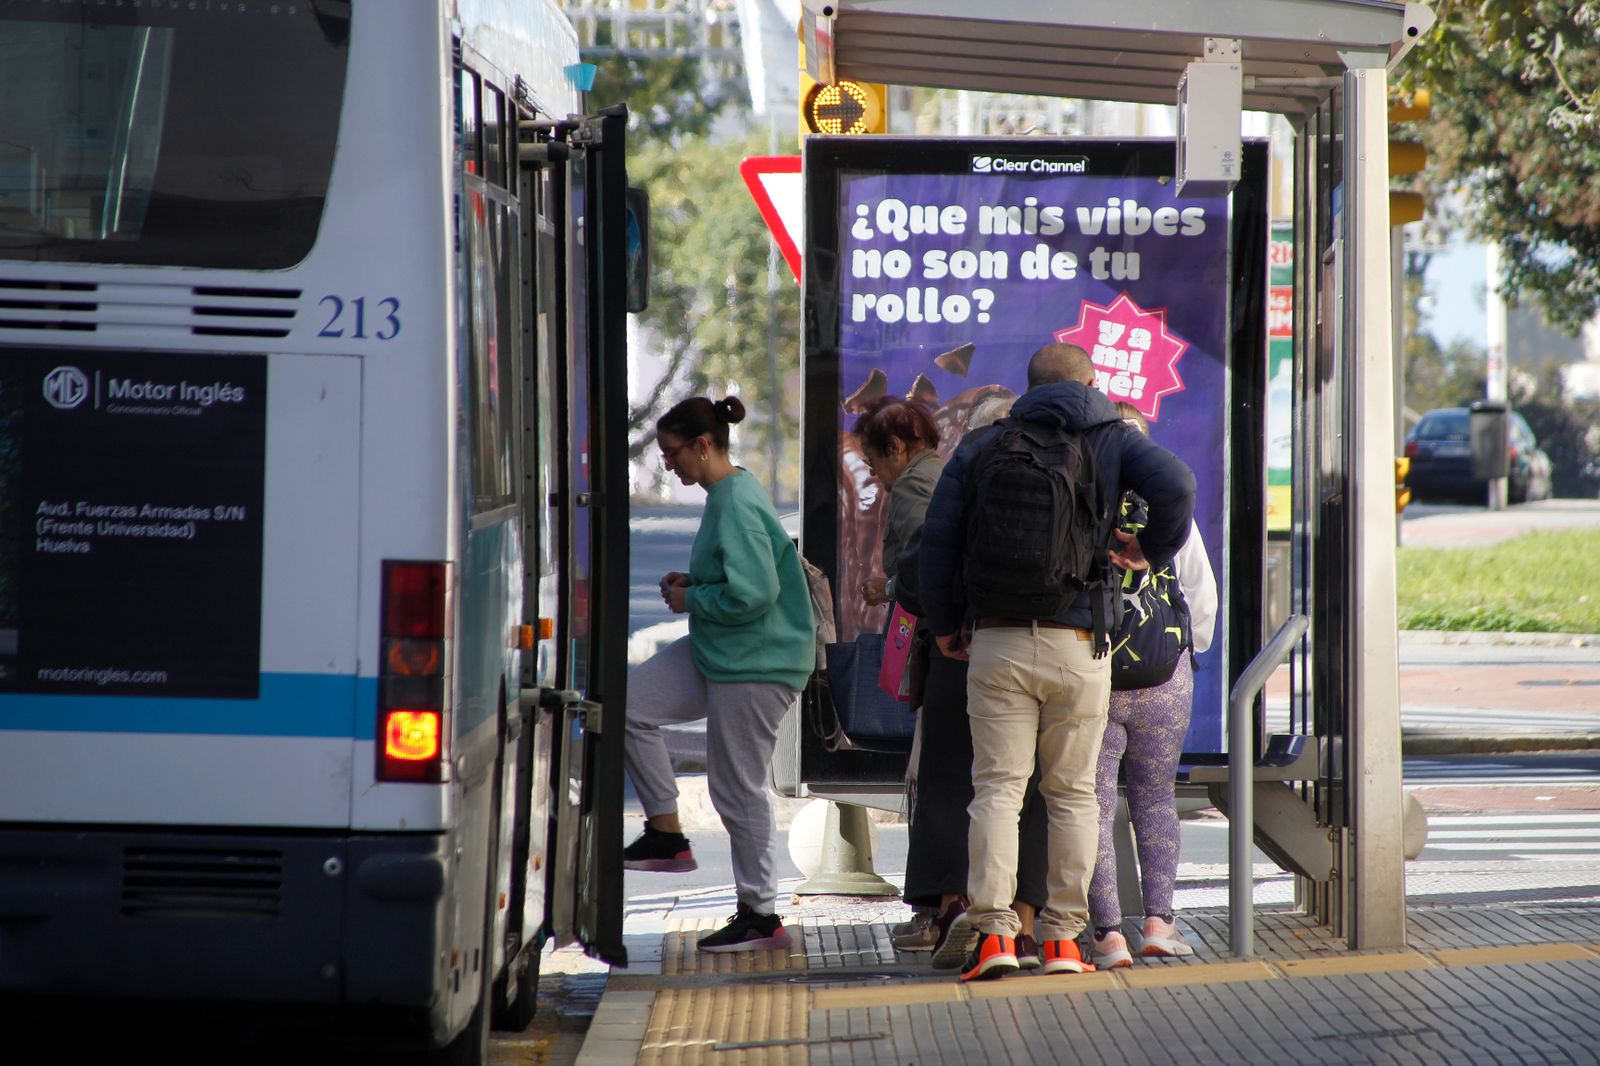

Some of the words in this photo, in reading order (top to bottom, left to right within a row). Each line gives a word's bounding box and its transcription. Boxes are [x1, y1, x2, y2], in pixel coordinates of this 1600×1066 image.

[992, 158, 1029, 172] Clear
[1030, 158, 1085, 173] Channel
[852, 198, 967, 241] ¿Que
[979, 197, 1064, 235] mis
[1076, 196, 1206, 236] vibes
[852, 249, 911, 279] no
[923, 250, 1008, 280] son
[1020, 244, 1078, 280] de
[1089, 247, 1140, 281] tu
[317, 295, 401, 340] 213
[852, 287, 995, 324] rollo?
[108, 378, 176, 400] Motor
[180, 381, 244, 406] Inglés
[36, 500, 72, 517] Avd.
[75, 502, 137, 518] Fuerzas
[139, 504, 210, 520] Armadas
[213, 505, 245, 520] S/N
[36, 517, 94, 535] (Frente
[97, 521, 196, 539] Universidad)
[36, 538, 91, 553] Huelva
[37, 667, 168, 685] motoringles.com
